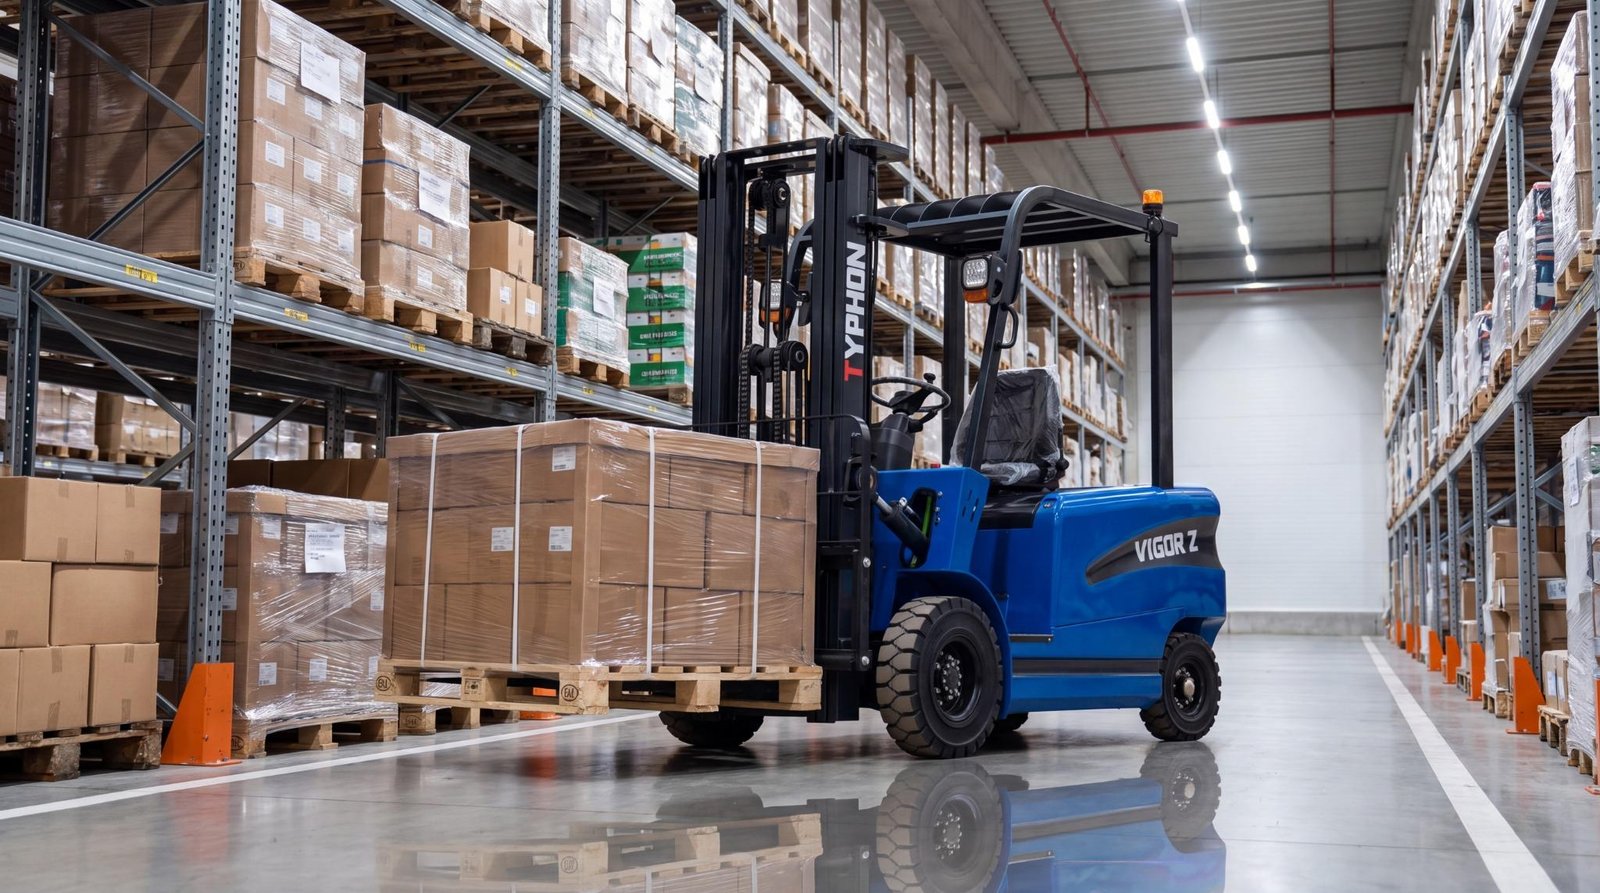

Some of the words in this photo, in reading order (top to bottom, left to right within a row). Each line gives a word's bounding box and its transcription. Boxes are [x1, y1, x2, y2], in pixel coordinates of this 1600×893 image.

[843, 241, 866, 381] TYPHON
[1134, 532, 1186, 562] VIGOR
[1187, 529, 1199, 552] Z
